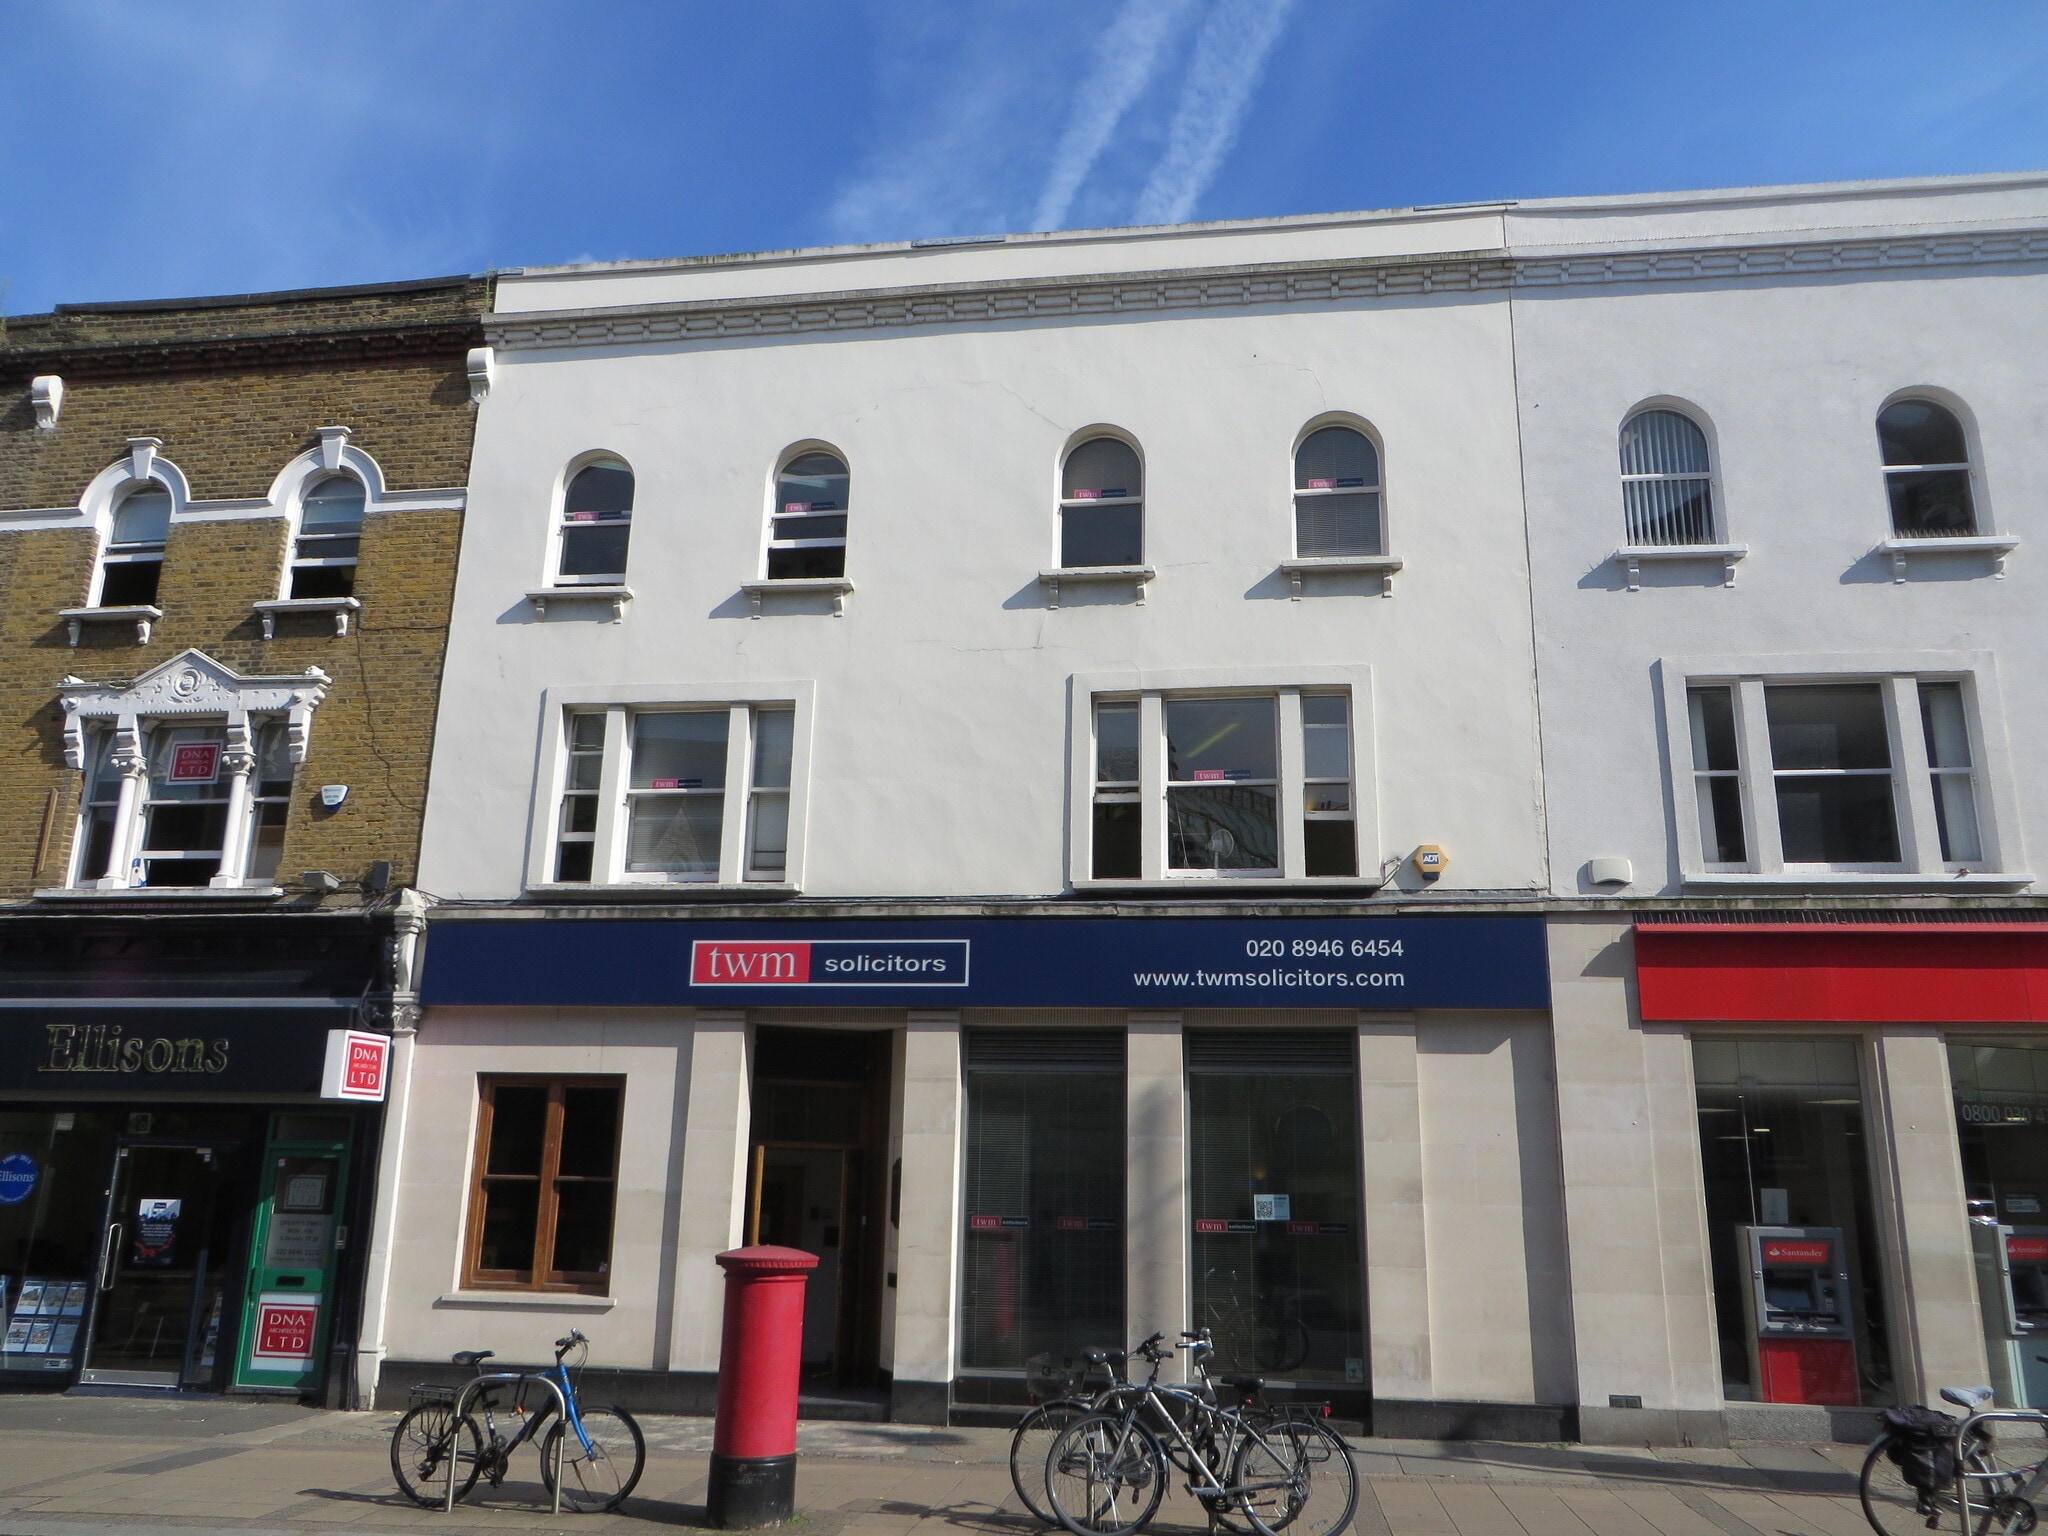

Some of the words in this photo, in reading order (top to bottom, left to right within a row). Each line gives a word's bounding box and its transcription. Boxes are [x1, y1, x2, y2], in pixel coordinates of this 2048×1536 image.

[181, 750, 209, 759] DNA
[1200, 772, 1219, 780] twm
[1423, 854, 1439, 863] ADT
[1246, 939, 1285, 957] 020
[1292, 939, 1344, 957] 8946
[1350, 939, 1404, 957] 6454
[709, 947, 796, 978] twm
[824, 955, 947, 972] solicitors
[1134, 969, 1405, 987] www.twmsolicitors.com
[37, 1024, 229, 1073] Ellisons
[353, 1047, 378, 1062] DNA
[350, 1071, 376, 1085] LTD
[1962, 1104, 2000, 1122] 0800
[977, 1218, 996, 1226] twm
[1063, 1219, 1083, 1227] twm
[1202, 1222, 1222, 1231] twm
[1293, 1223, 1313, 1232] twm
[1781, 1248, 1823, 1257] Santander
[269, 1313, 306, 1326] DNA
[266, 1336, 304, 1349] LTD
